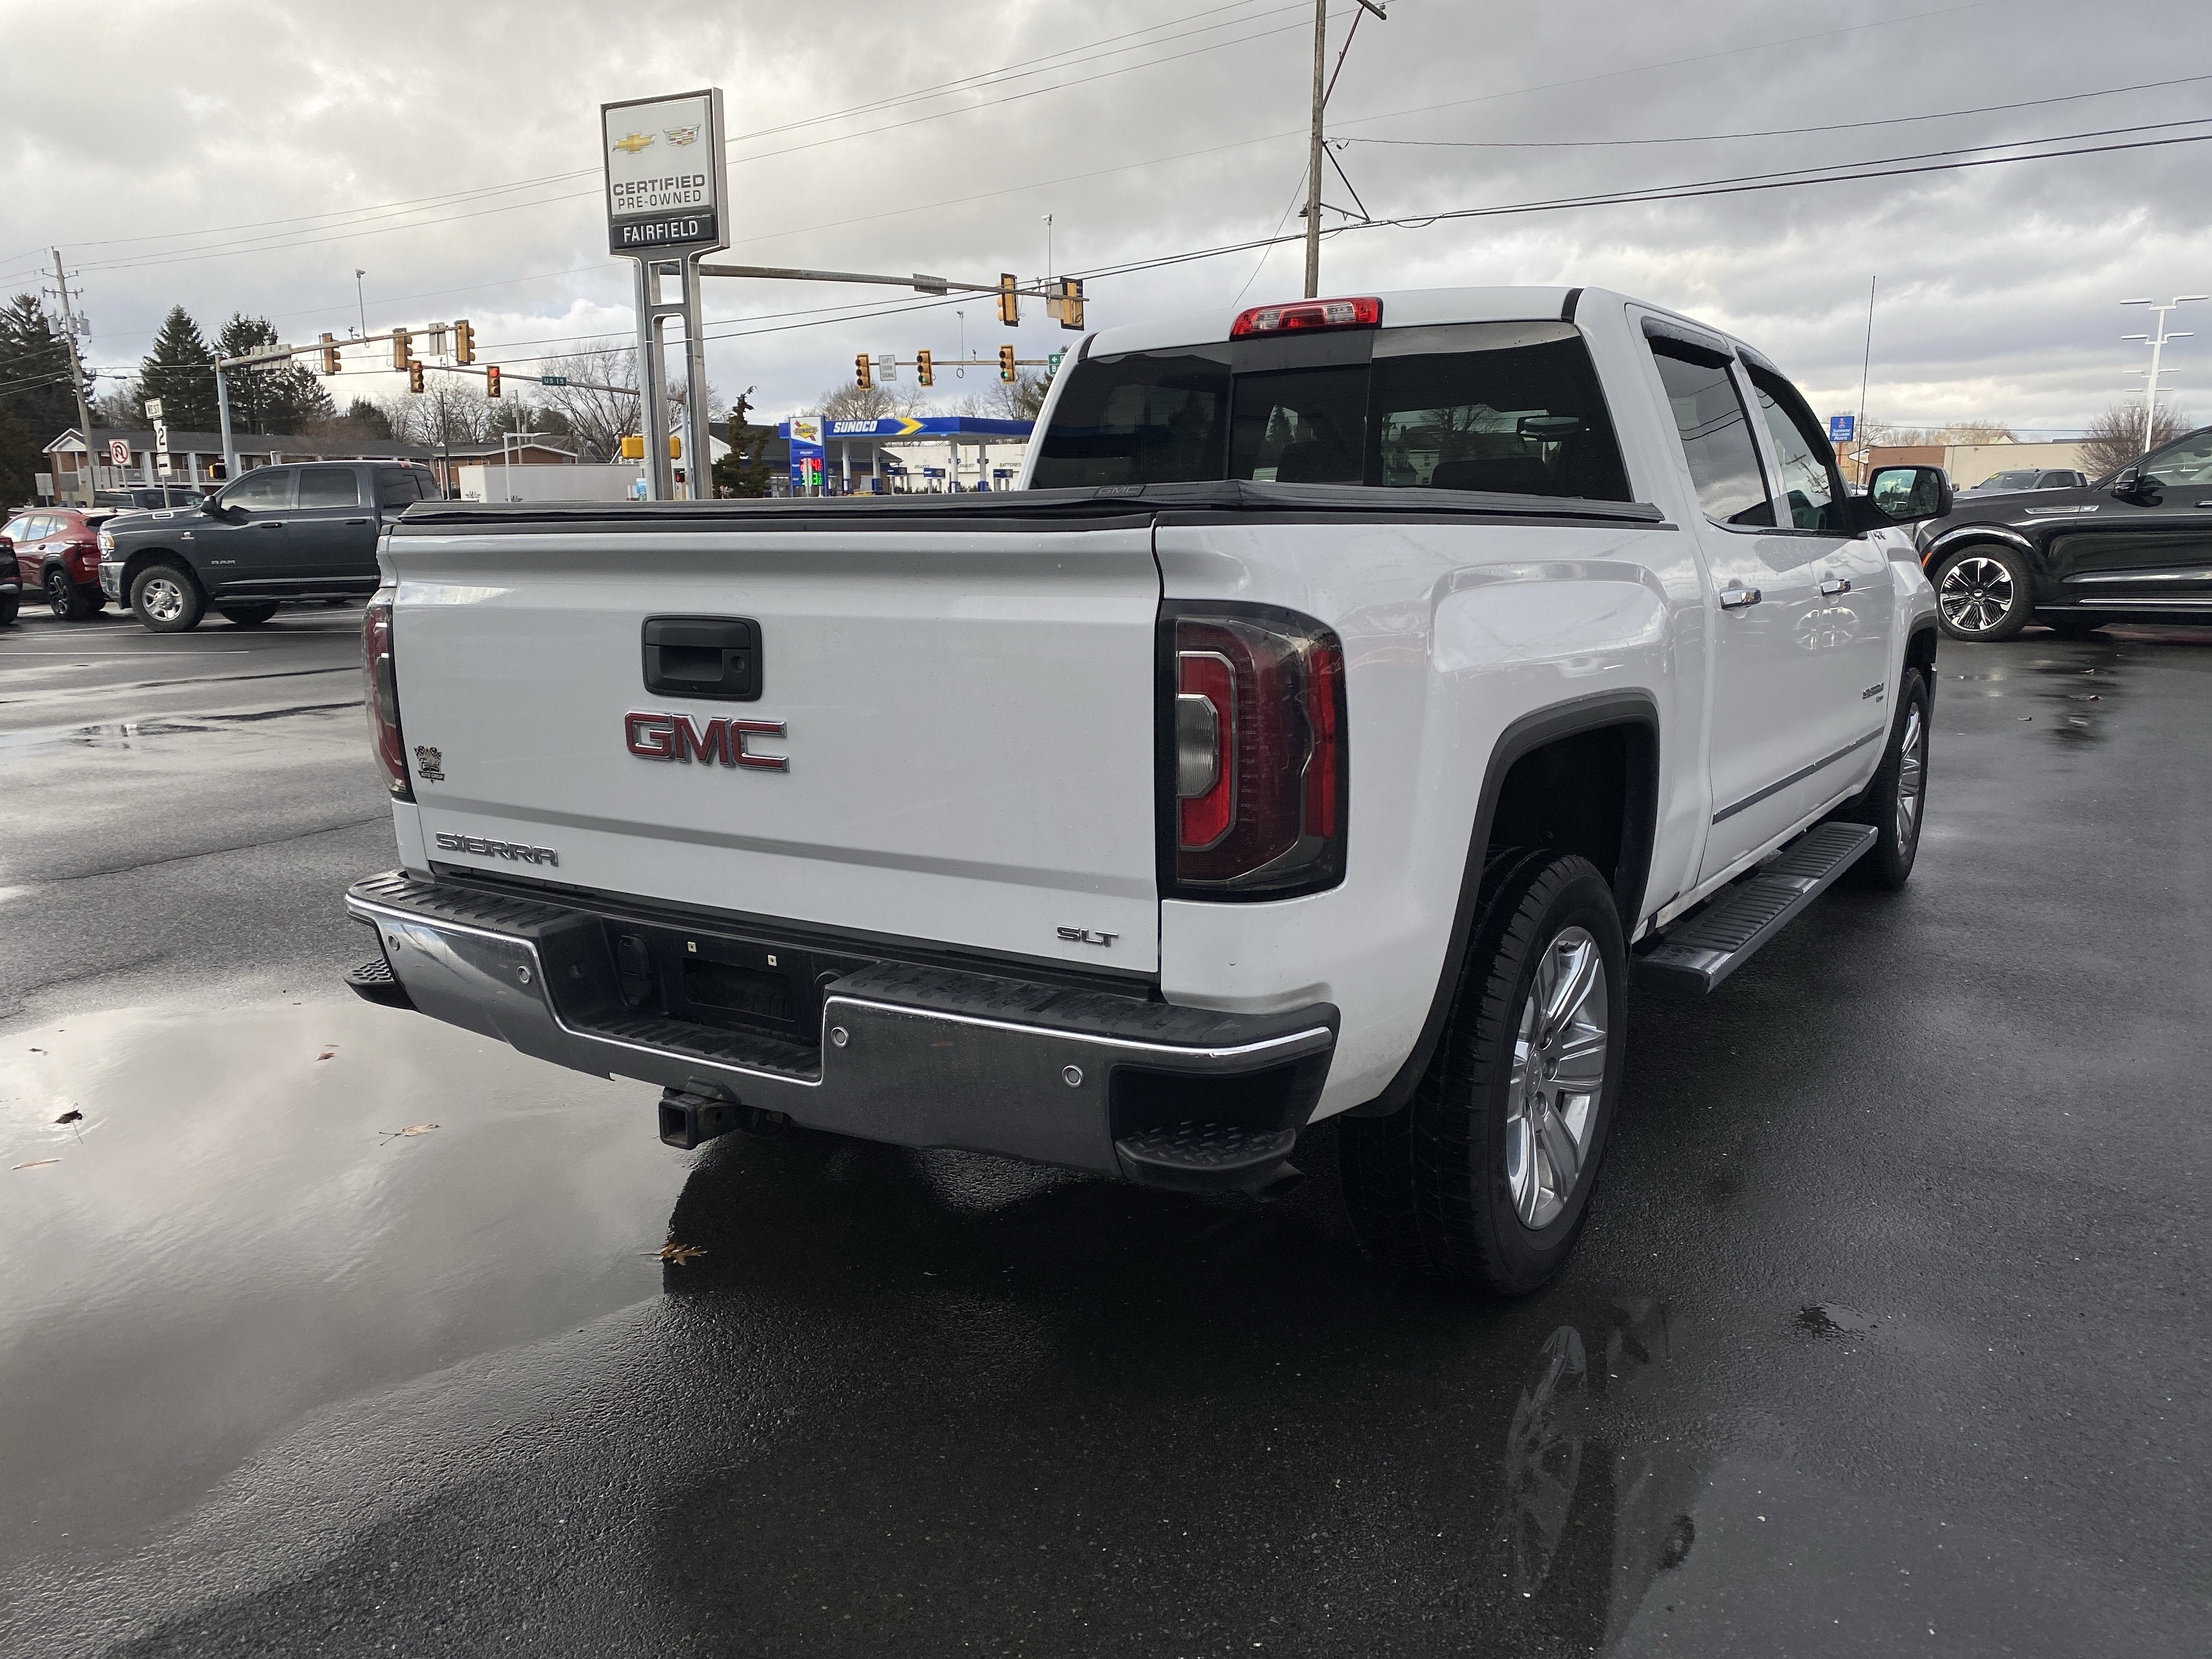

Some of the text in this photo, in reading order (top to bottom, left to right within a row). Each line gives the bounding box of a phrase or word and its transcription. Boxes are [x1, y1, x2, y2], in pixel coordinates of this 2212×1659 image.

[613, 174, 705, 196] CERTIFIED
[618, 190, 701, 210] PRE-OWNED
[623, 220, 698, 242] FAIRFIELD
[146, 404, 160, 415] WEST
[833, 420, 878, 433] SUNOCO
[1099, 486, 1141, 494] GMC
[625, 711, 790, 772] GMC
[436, 831, 559, 867] SIERRA
[1057, 926, 1119, 948] SLT
